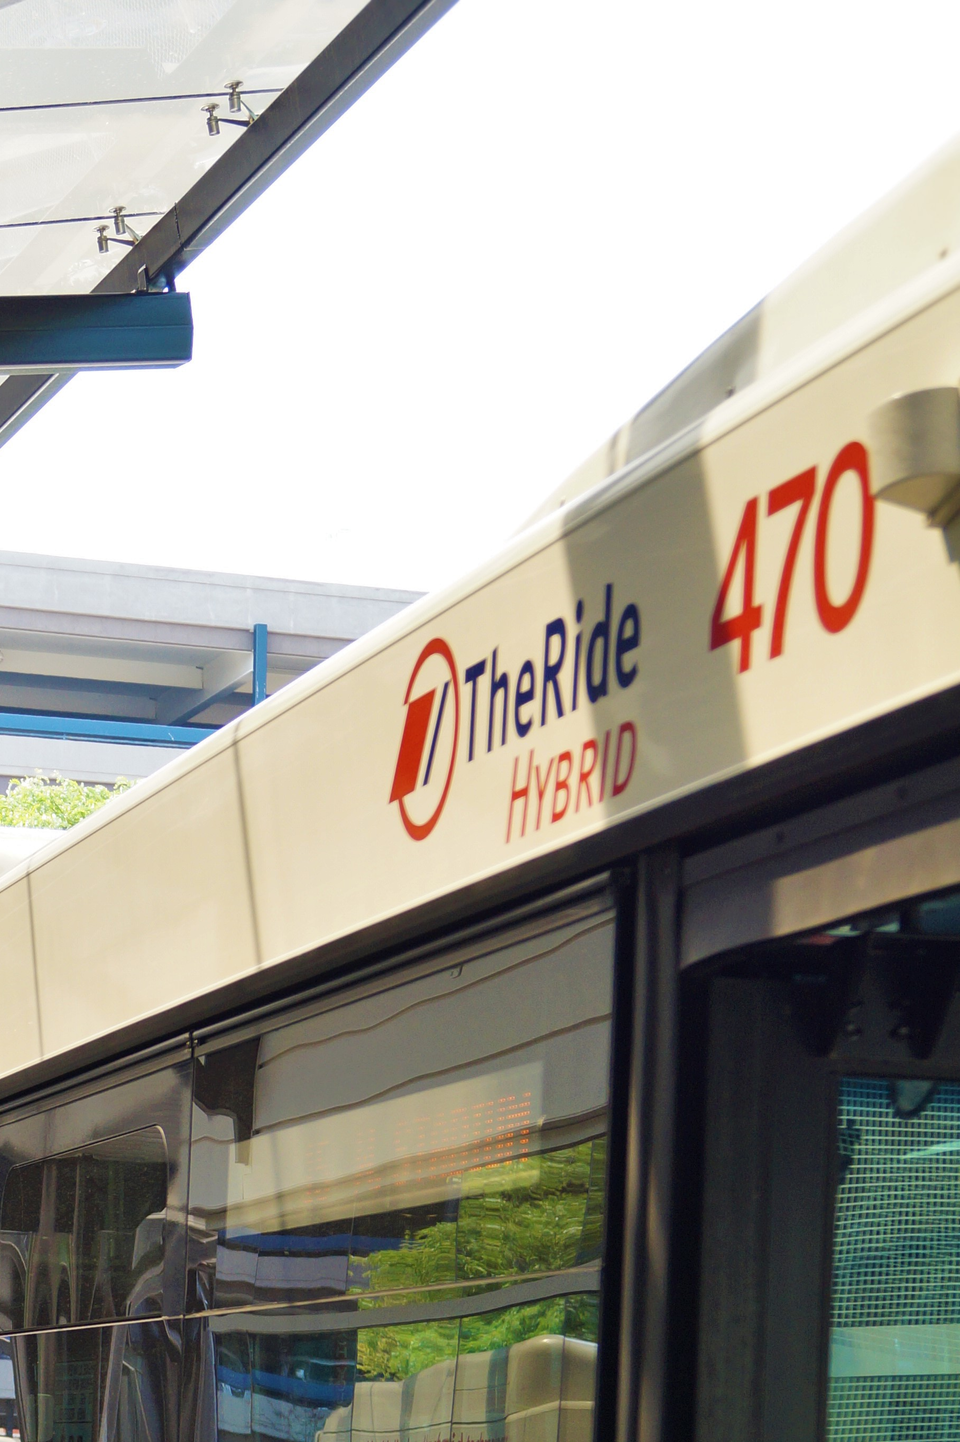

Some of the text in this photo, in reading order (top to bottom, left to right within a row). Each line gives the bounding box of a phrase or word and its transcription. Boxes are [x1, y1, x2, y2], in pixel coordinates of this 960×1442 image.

[708, 440, 876, 675] 470
[464, 582, 642, 763] TheRide
[505, 719, 638, 844] HYBRID
